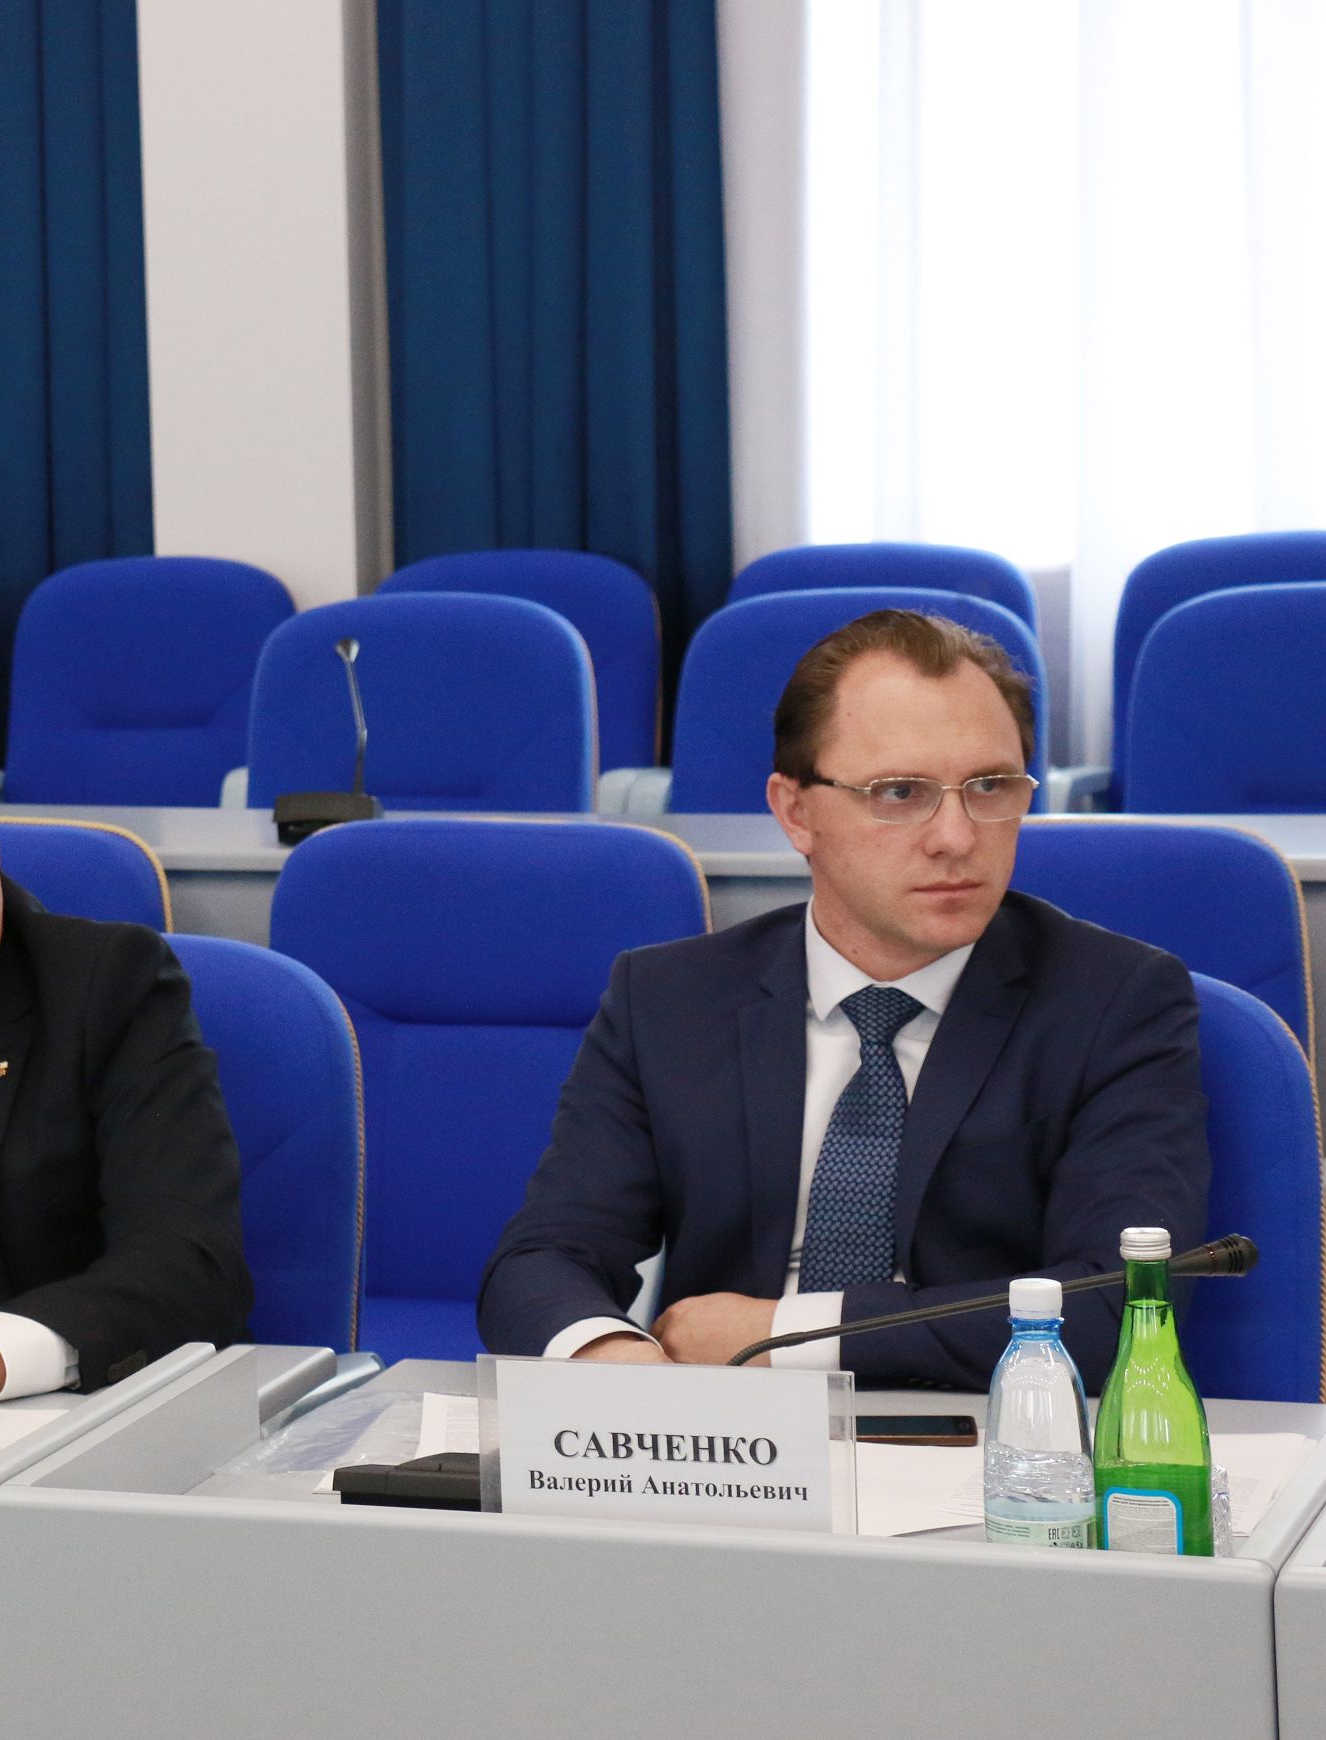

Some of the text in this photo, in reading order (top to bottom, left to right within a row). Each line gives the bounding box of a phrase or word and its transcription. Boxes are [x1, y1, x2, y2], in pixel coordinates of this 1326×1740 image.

[554, 1429, 778, 1466] САВЧЕНКО
[529, 1470, 808, 1501] Валерий Анатольевич
